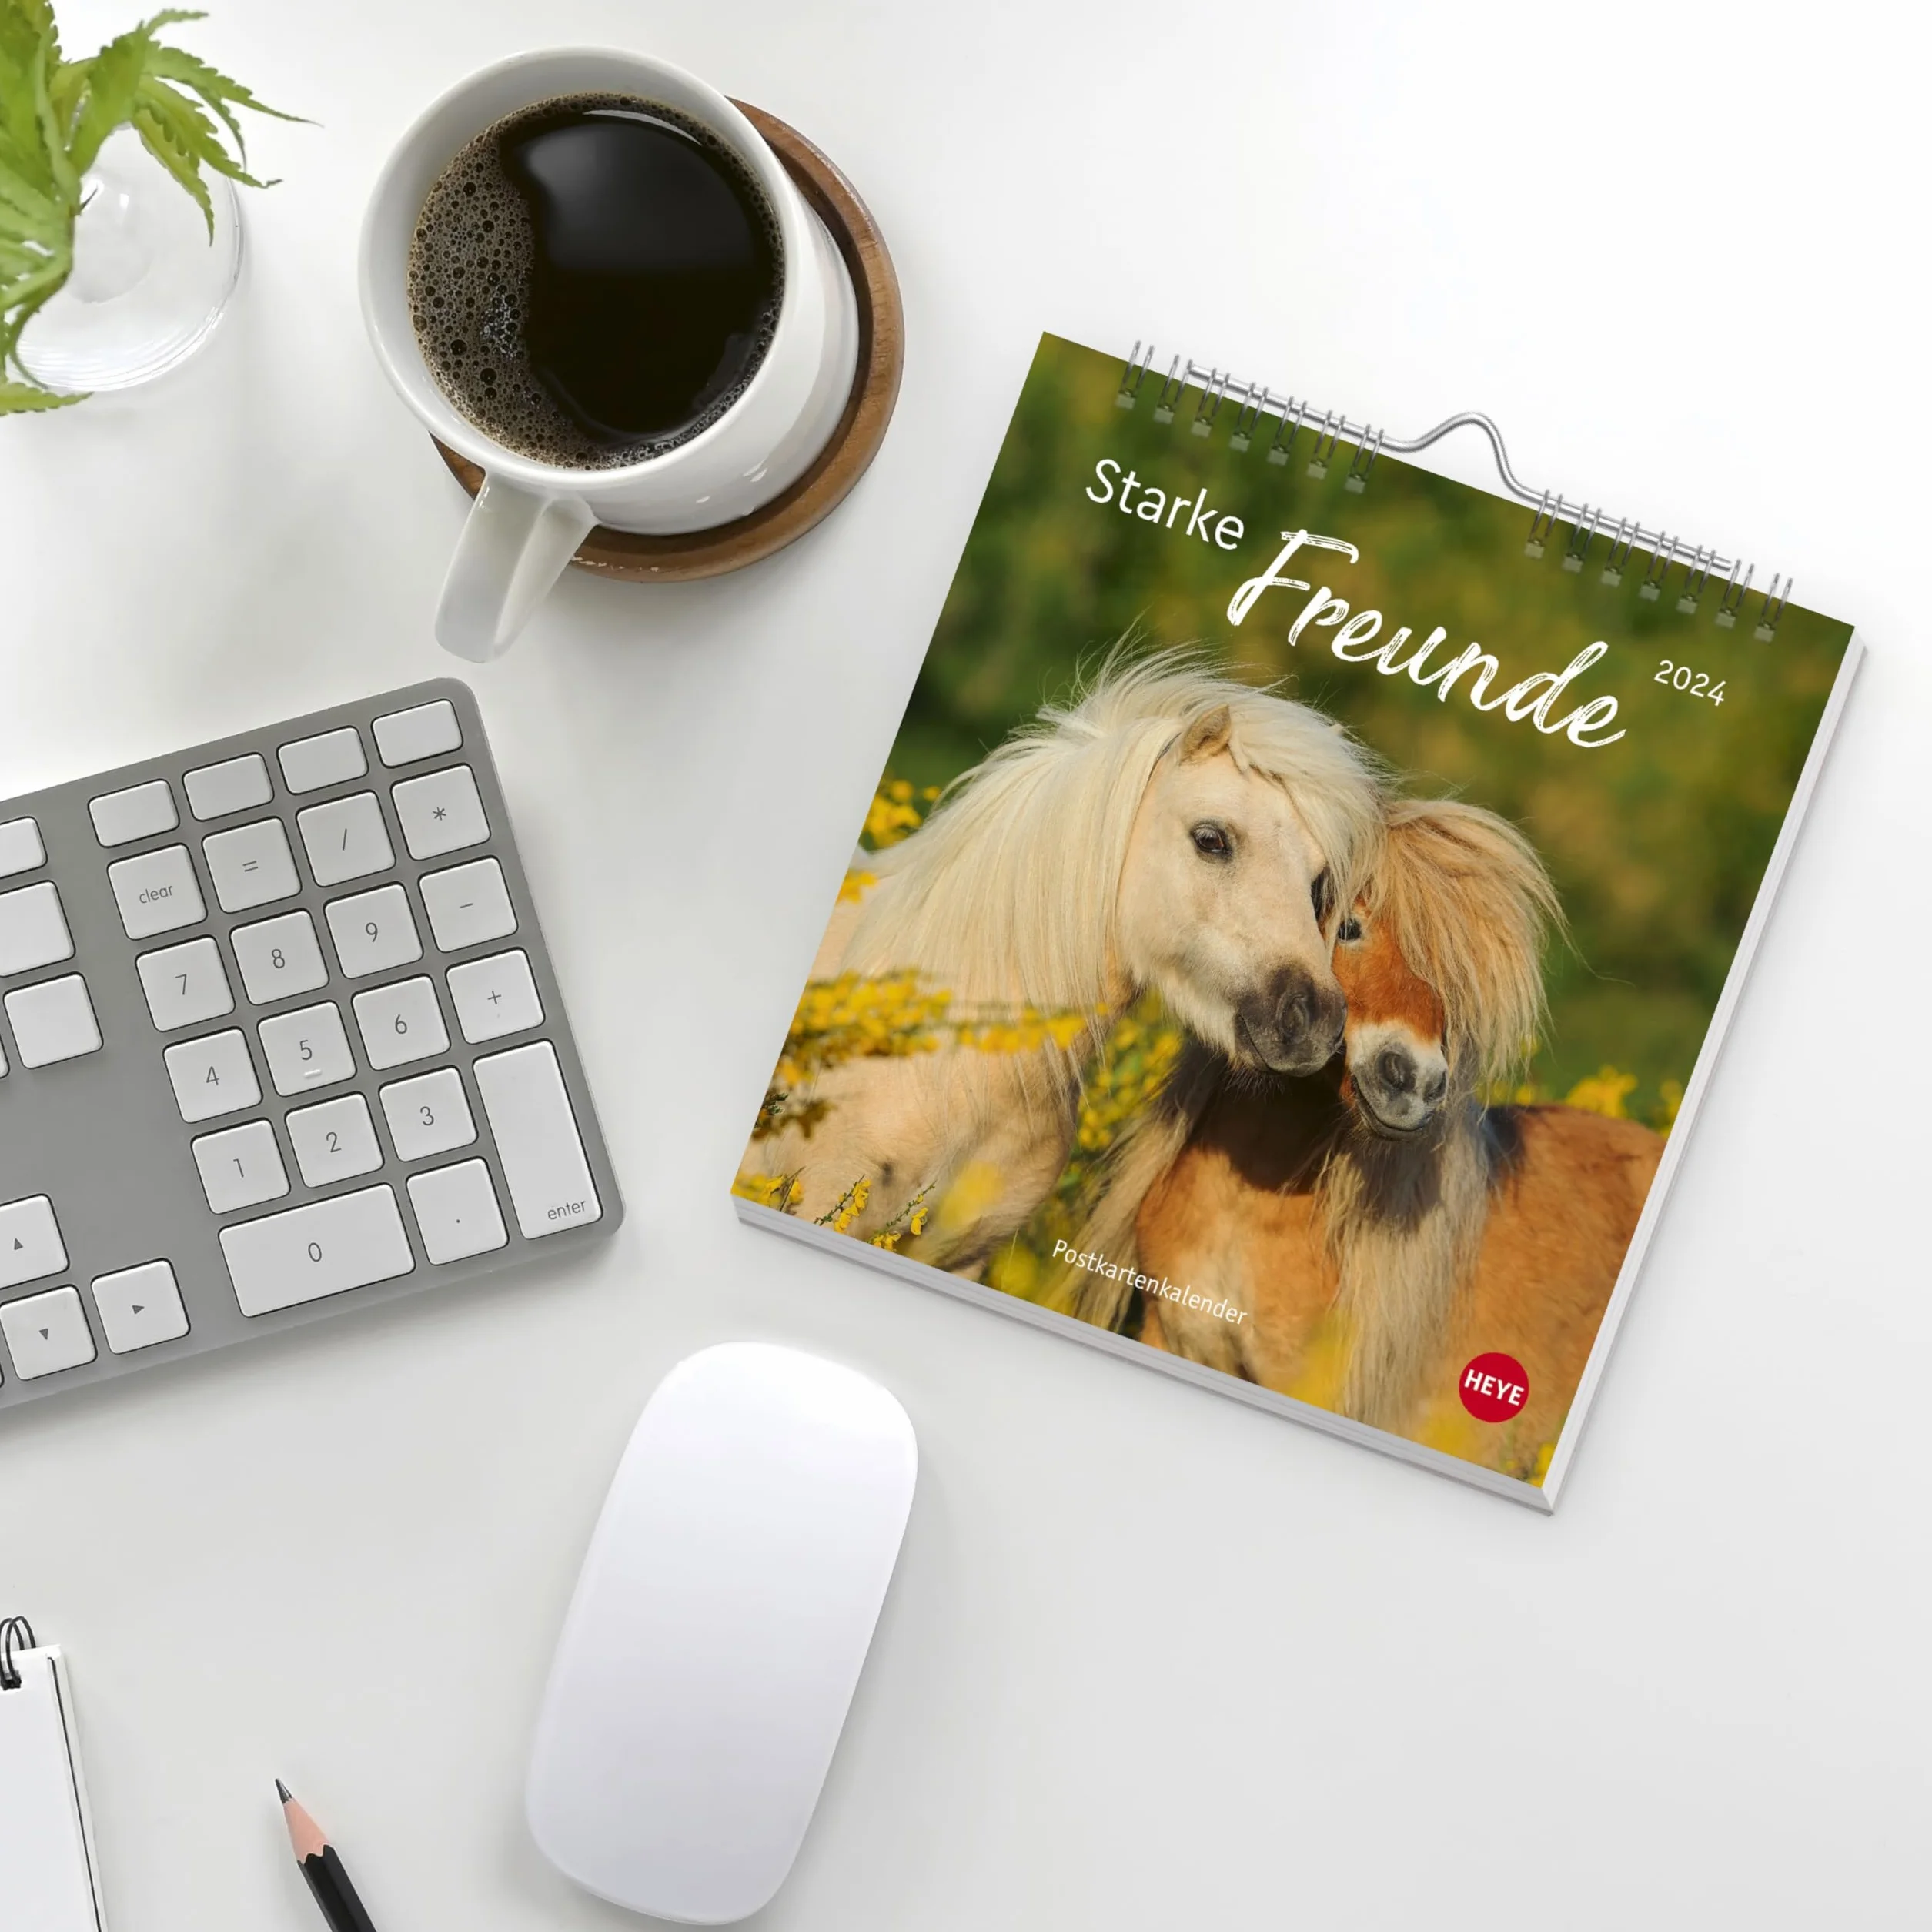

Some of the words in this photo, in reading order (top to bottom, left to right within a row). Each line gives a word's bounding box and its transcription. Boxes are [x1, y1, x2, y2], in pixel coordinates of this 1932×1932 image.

[1086, 459, 1244, 550] Starke
[1226, 529, 1626, 748] Freunde
[1654, 660, 1726, 706] 2024
[139, 883, 174, 904] clear
[365, 921, 379, 943] 9
[271, 948, 286, 970] 8
[175, 974, 189, 996] 7
[394, 1014, 408, 1035] 6
[299, 1039, 313, 1061] 5
[206, 1065, 220, 1086] 4
[419, 1105, 435, 1127] 3
[326, 1131, 342, 1154] 2
[232, 1158, 245, 1178] 1
[547, 1198, 588, 1222] enter
[307, 1242, 323, 1263] 0
[1051, 1238, 1248, 1327] Postkartenkalender
[1464, 1369, 1524, 1406] HEYE
